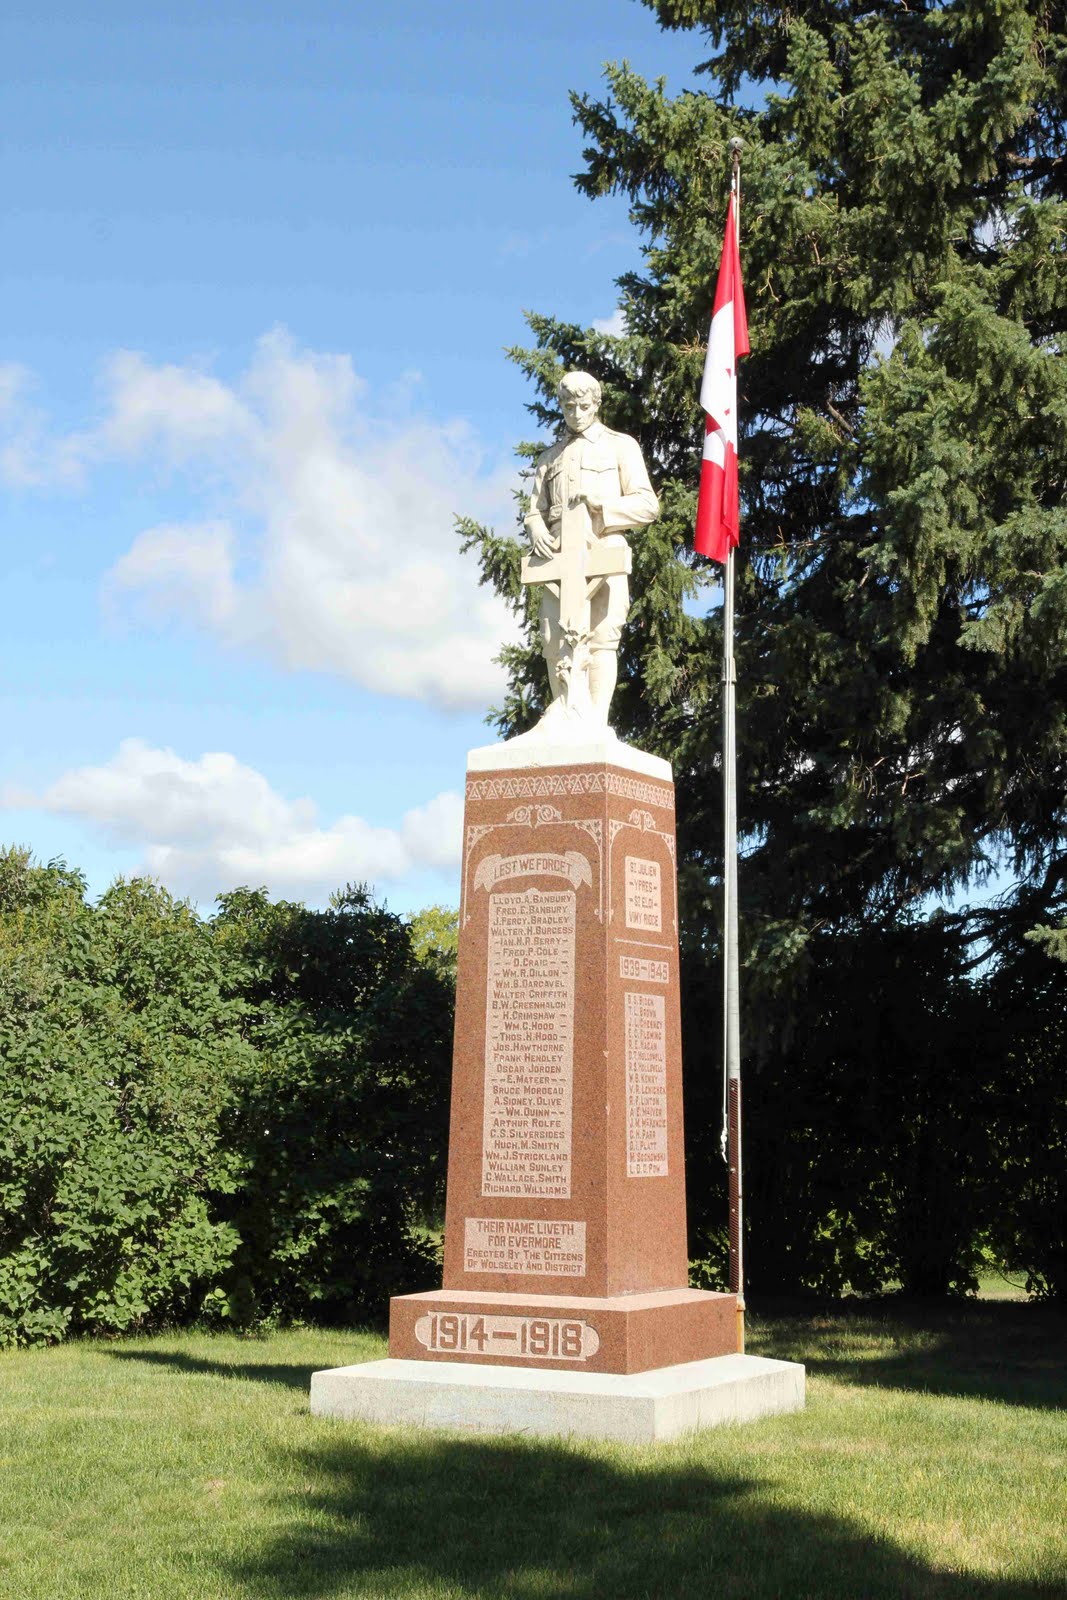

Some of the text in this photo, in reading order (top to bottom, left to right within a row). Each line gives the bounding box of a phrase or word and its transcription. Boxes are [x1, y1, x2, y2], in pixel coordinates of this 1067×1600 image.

[494, 858, 572, 879] LEST WE FORGET
[493, 990, 568, 999] WALTER GRIFFITH
[493, 1053, 563, 1062] FRANK HENDLEY
[496, 1064, 561, 1073] OSCAR JORDEN
[493, 1085, 520, 1095] BRUCE
[493, 1118, 561, 1127] ARTHUR ROLFE
[489, 1161, 564, 1172] WILLIAM SUNLEY
[484, 1182, 567, 1194] RICHARD WILLIAMS
[477, 1221, 574, 1235] THEIR NAME LIVETH
[488, 1235, 561, 1249] FOR EVERMORE
[467, 1248, 583, 1261] ERECTED BY THE CITIZENS
[467, 1259, 582, 1273] OF WOLSELEY AND DISTRICT
